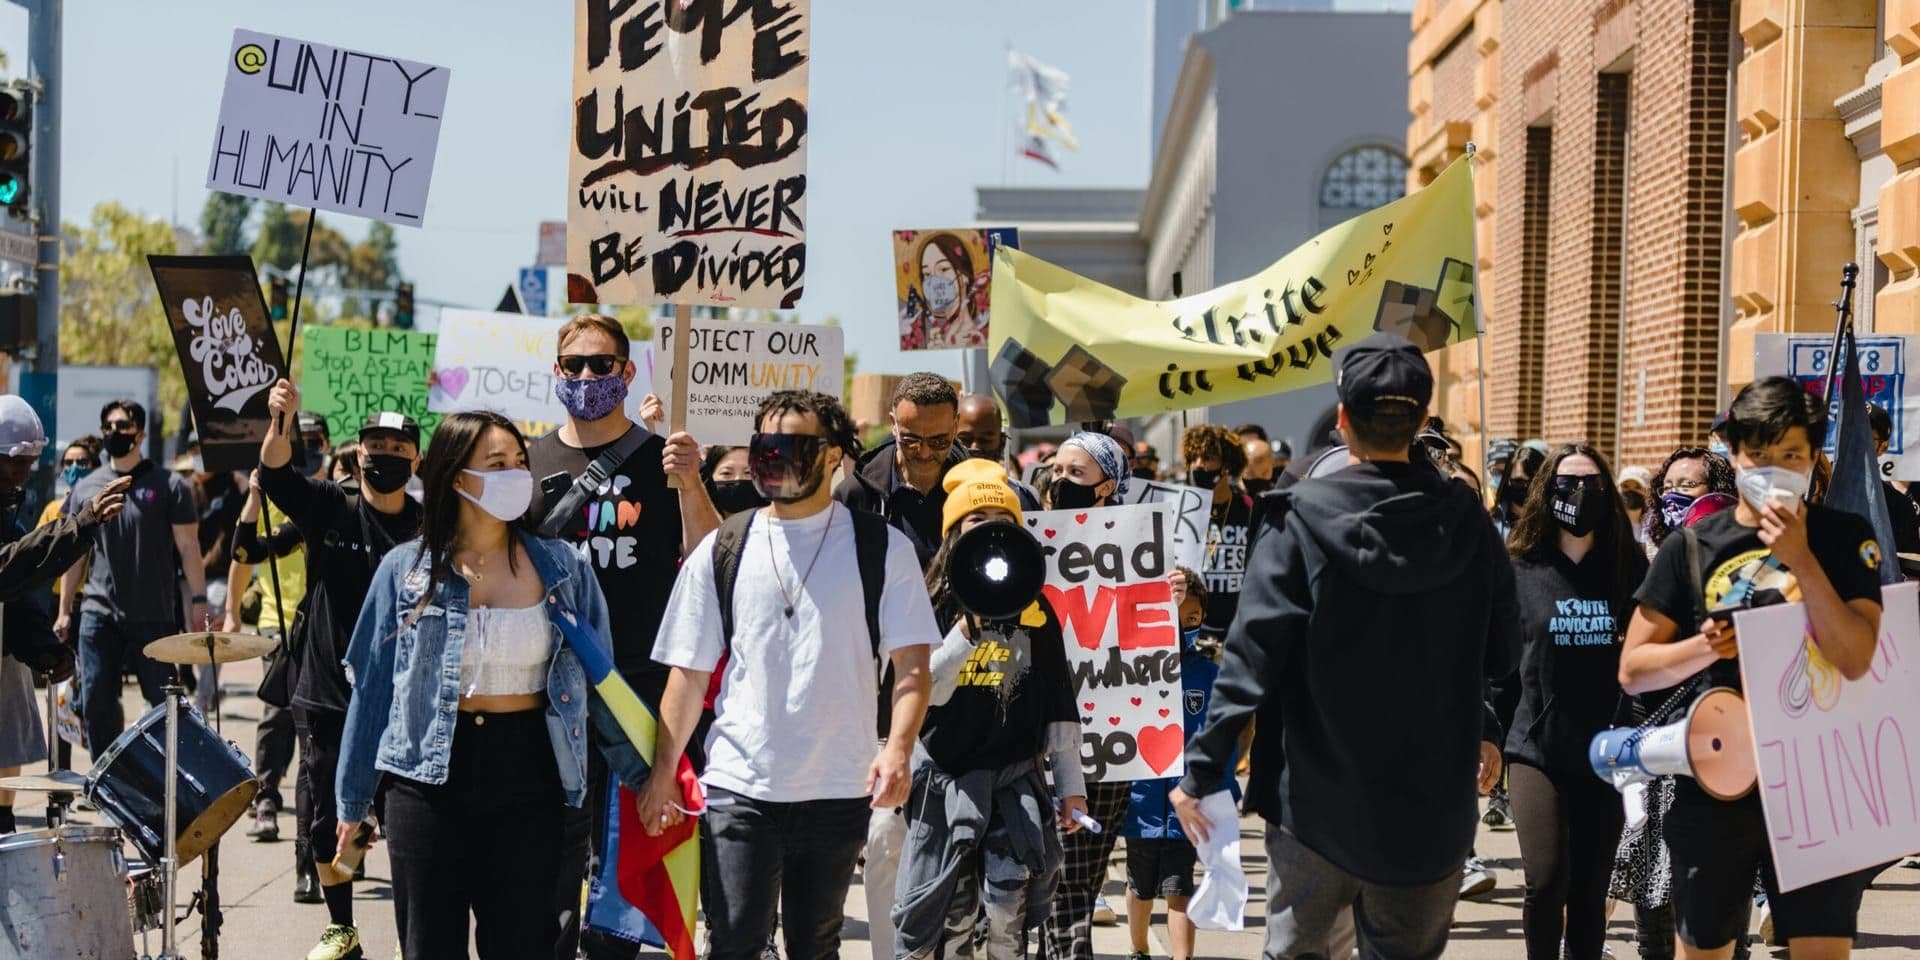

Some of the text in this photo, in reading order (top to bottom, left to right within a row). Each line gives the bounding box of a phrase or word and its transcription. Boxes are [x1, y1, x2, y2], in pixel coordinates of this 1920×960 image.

[657, 174, 807, 233] NEVER
[589, 231, 647, 287] BE
[182, 295, 247, 363] Love
[344, 329, 409, 355] BLM
[661, 326, 819, 357] POTECT OUR
[202, 332, 278, 396] Color
[670, 361, 822, 392] OMMUNITY
[331, 391, 429, 417] STRONG
[1207, 524, 1249, 545] ACK
[1554, 633, 1613, 647] FOR CHANGE
[1760, 716, 1917, 850] UNITE
